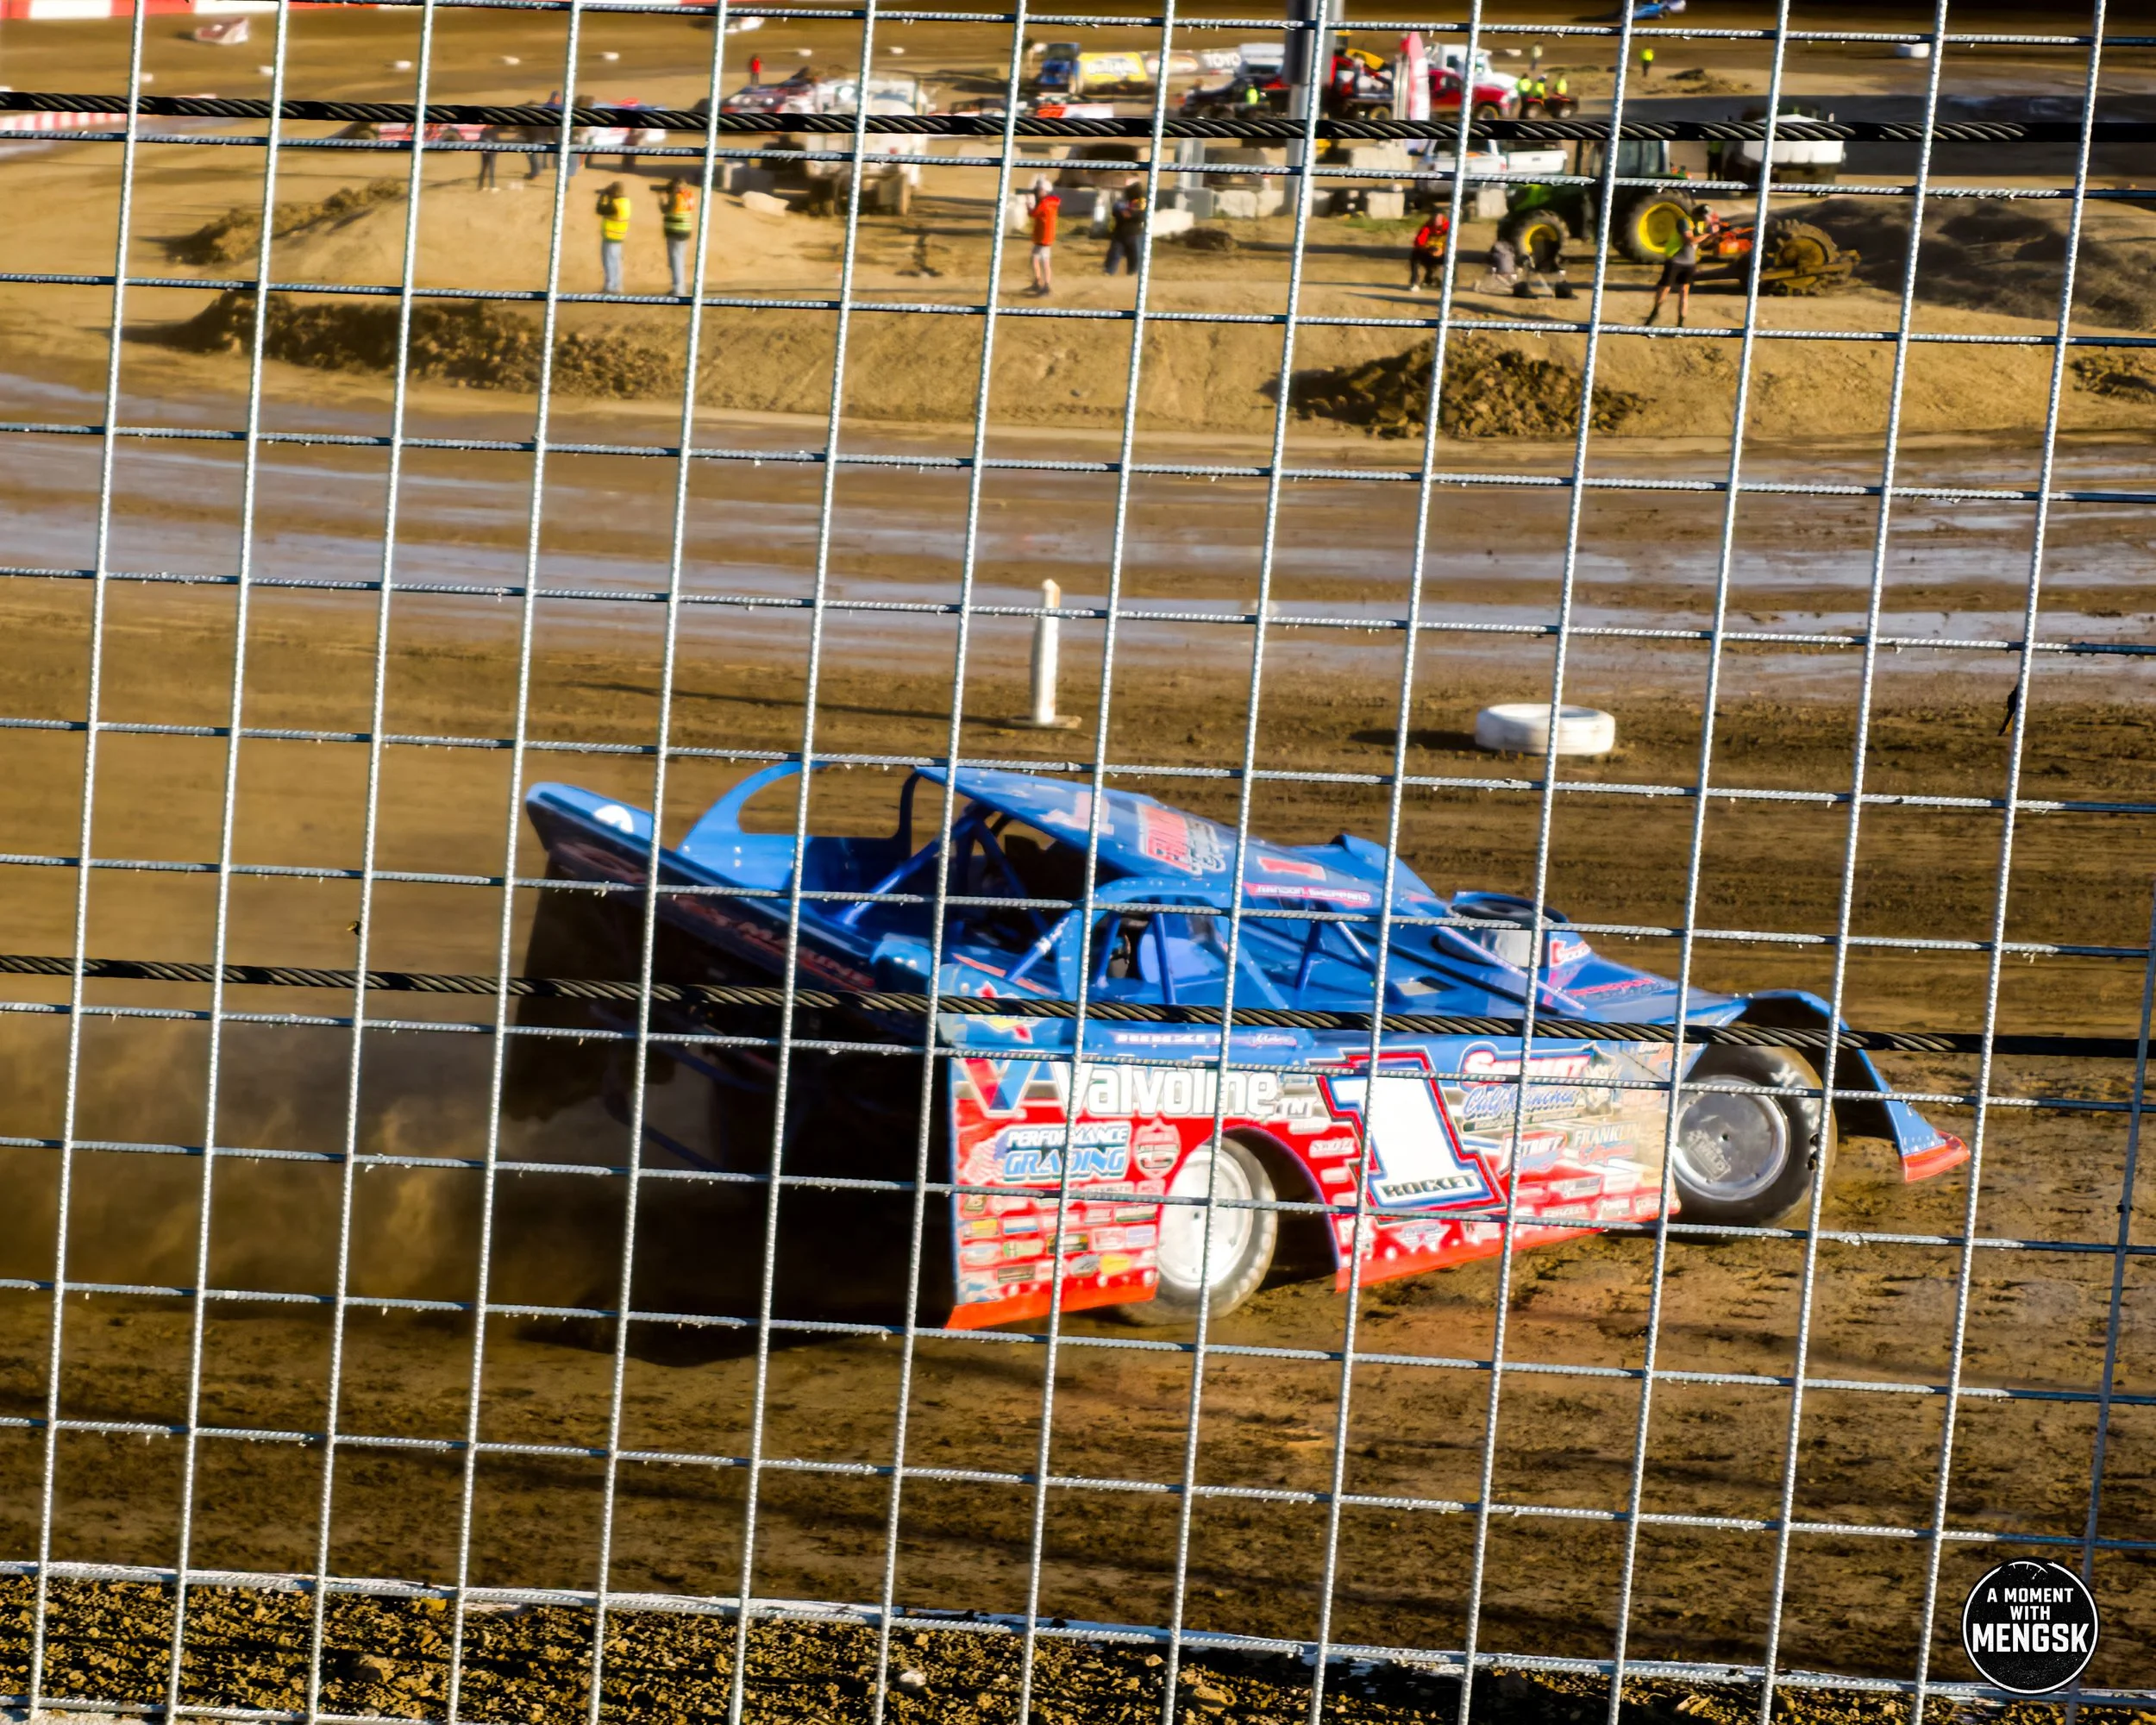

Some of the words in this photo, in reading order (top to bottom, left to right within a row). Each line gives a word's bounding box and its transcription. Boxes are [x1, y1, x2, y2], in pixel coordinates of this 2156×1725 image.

[1202, 53, 1241, 68] TOYO
[1051, 1053, 1279, 1118] Valvoline
[1381, 1174, 1477, 1198] ROCKET
